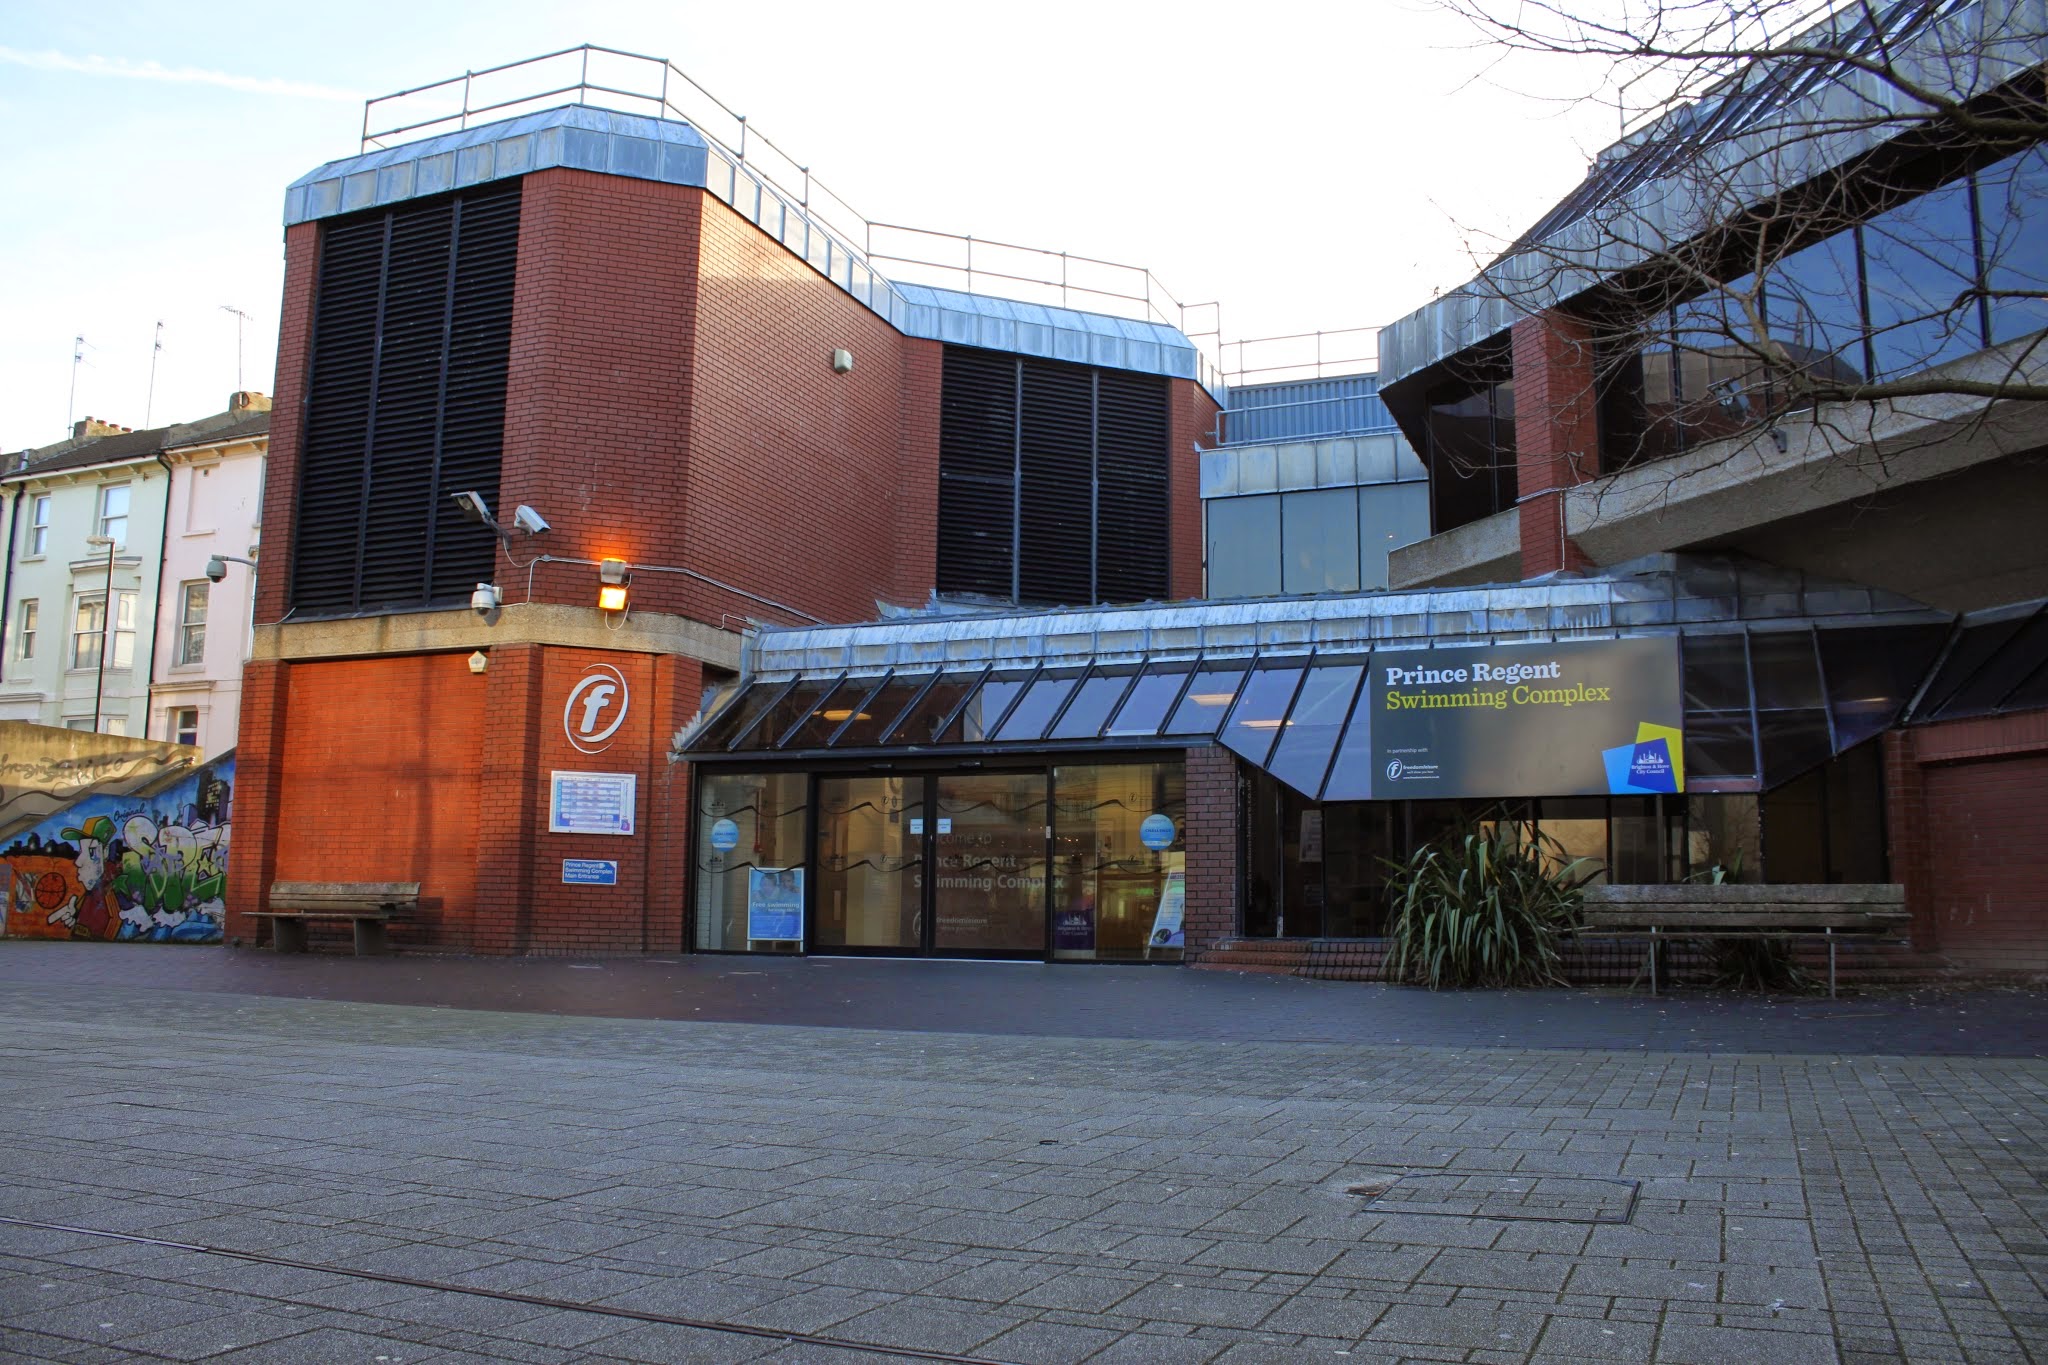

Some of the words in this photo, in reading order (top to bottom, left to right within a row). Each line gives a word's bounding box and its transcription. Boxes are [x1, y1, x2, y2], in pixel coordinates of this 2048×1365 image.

[1386, 665, 1468, 686] Prince
[1472, 661, 1561, 685] Regent
[1386, 688, 1508, 711] Swimming
[1512, 682, 1611, 707] Complex
[580, 684, 616, 734] f
[113, 803, 148, 822] Original
[963, 853, 1016, 871] Regent
[913, 874, 992, 891] Simming
[997, 874, 1064, 891] Complx
[767, 901, 800, 909] swimming
